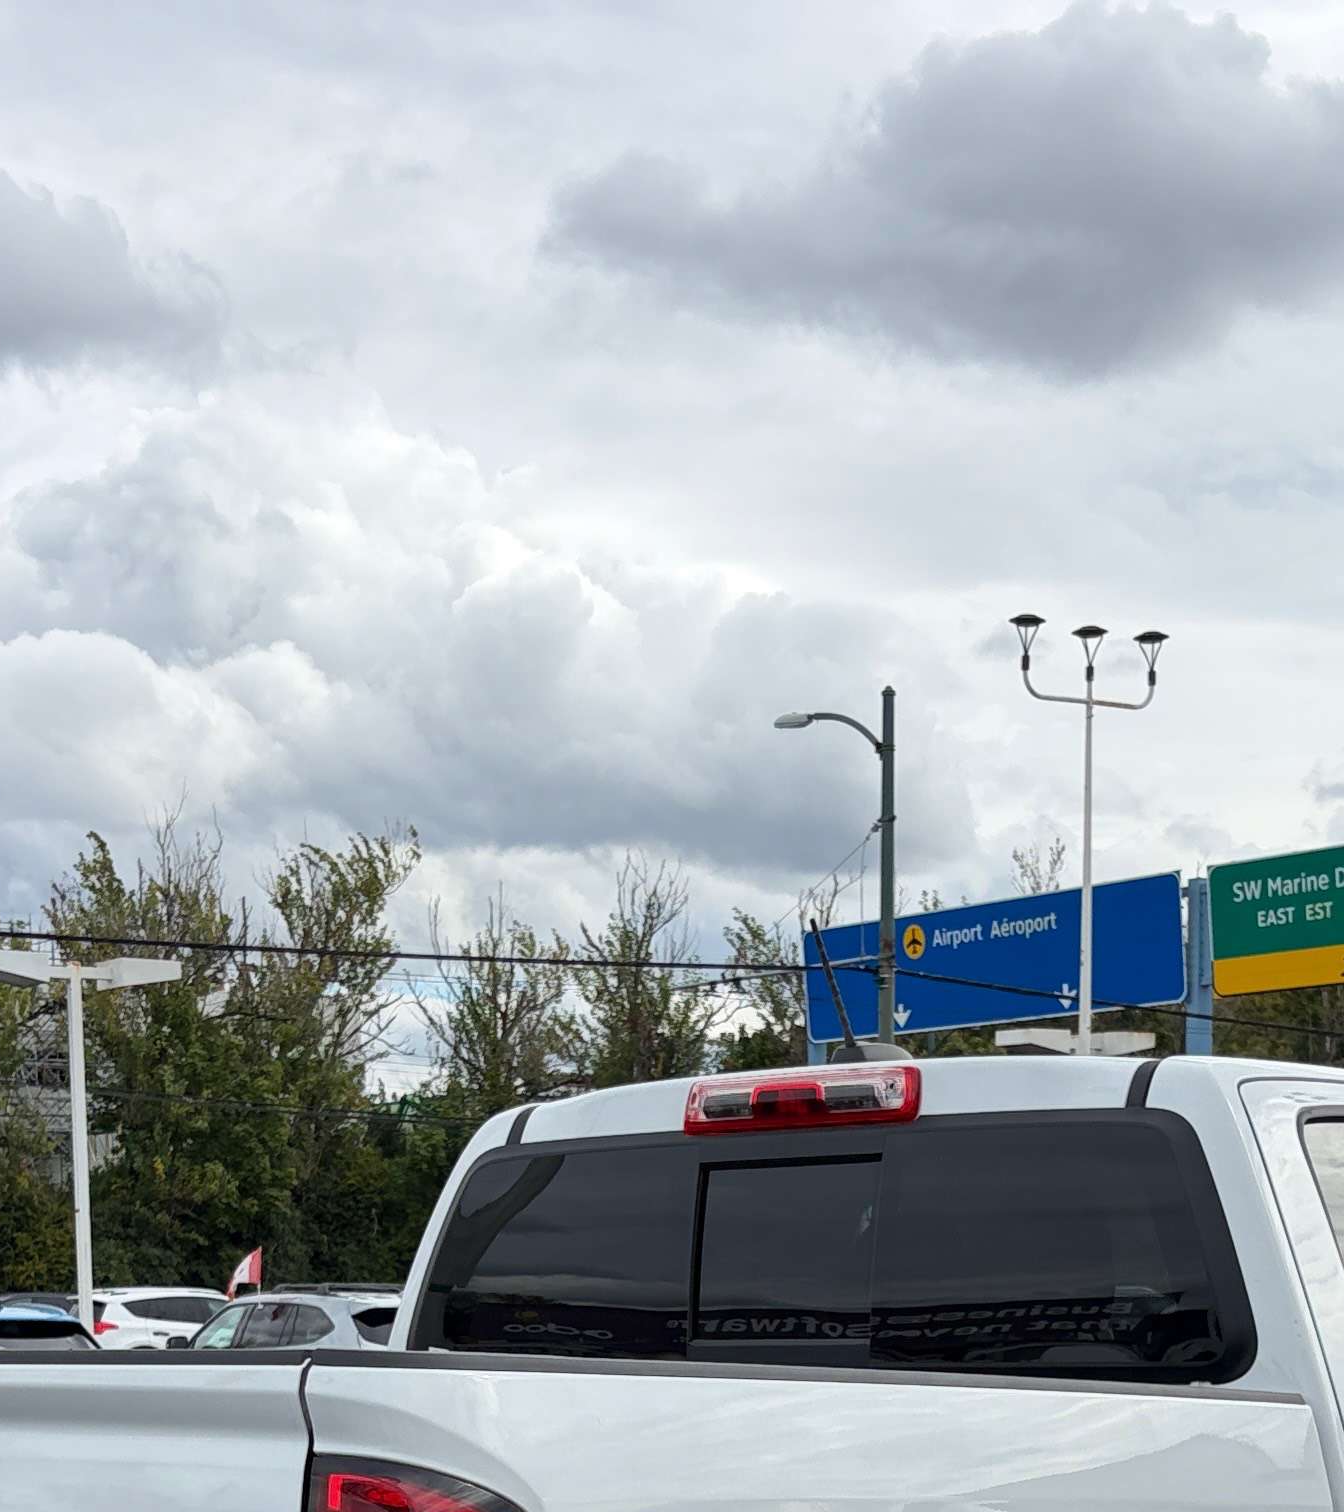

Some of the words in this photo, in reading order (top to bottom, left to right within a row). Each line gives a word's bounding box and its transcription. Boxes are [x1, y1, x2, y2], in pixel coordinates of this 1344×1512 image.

[1232, 880, 1261, 903] SW
[1267, 873, 1329, 897] Marine
[1258, 907, 1295, 927] EAST
[1305, 902, 1333, 921] EST
[932, 924, 983, 949] Airport
[991, 912, 1057, 939] Aéroport
